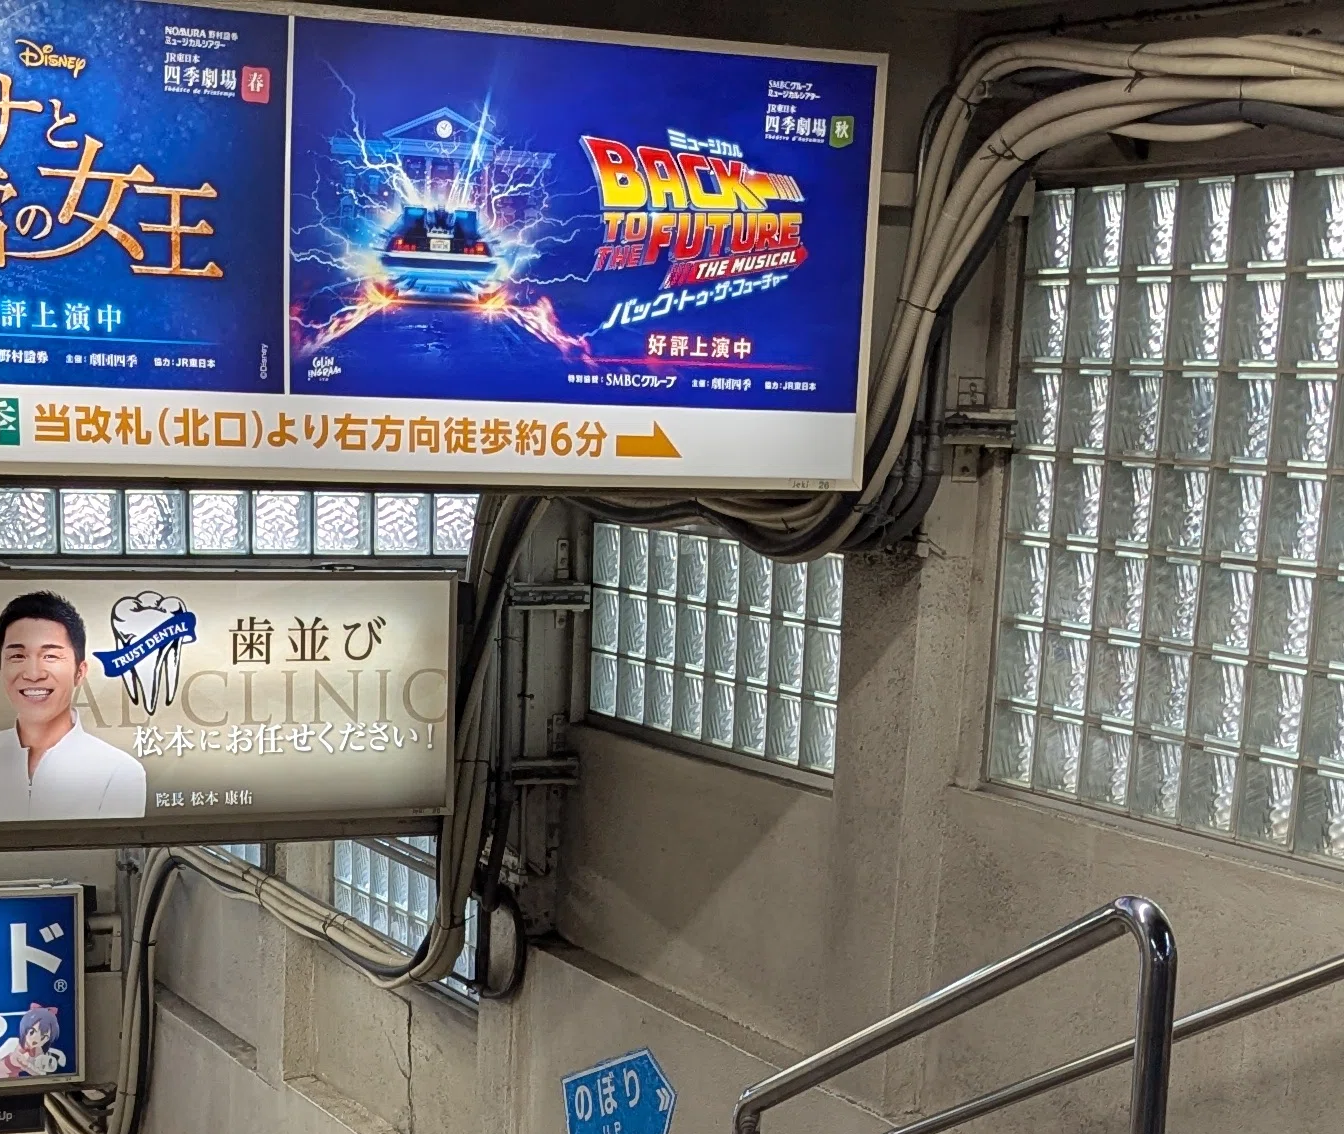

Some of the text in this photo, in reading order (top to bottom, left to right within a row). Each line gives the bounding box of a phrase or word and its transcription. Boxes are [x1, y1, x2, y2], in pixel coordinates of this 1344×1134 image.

[164, 26, 206, 39] NOMURA
[164, 52, 200, 63] JR東日本
[164, 65, 264, 92] 四季劇場 春
[768, 80, 813, 91] SMBCグループ
[766, 103, 796, 114] JR東日本
[765, 115, 849, 138] 四季劇場 秋
[667, 128, 743, 158] ミュージカル
[580, 135, 770, 211] BACK
[594, 212, 803, 272] TO THE FUTURE
[695, 250, 798, 280] THE MUSICAL
[603, 272, 788, 329] バック・トゥ・ザ・フューチャー
[648, 334, 753, 360] 好評上演中
[111, 620, 189, 669] TRUST DENTAL
[228, 615, 387, 666] 歯並び
[181, 667, 447, 727] CLINIC
[156, 792, 184, 808] 院長
[191, 791, 219, 807] 松本
[575, 1068, 640, 1121] のぼり
